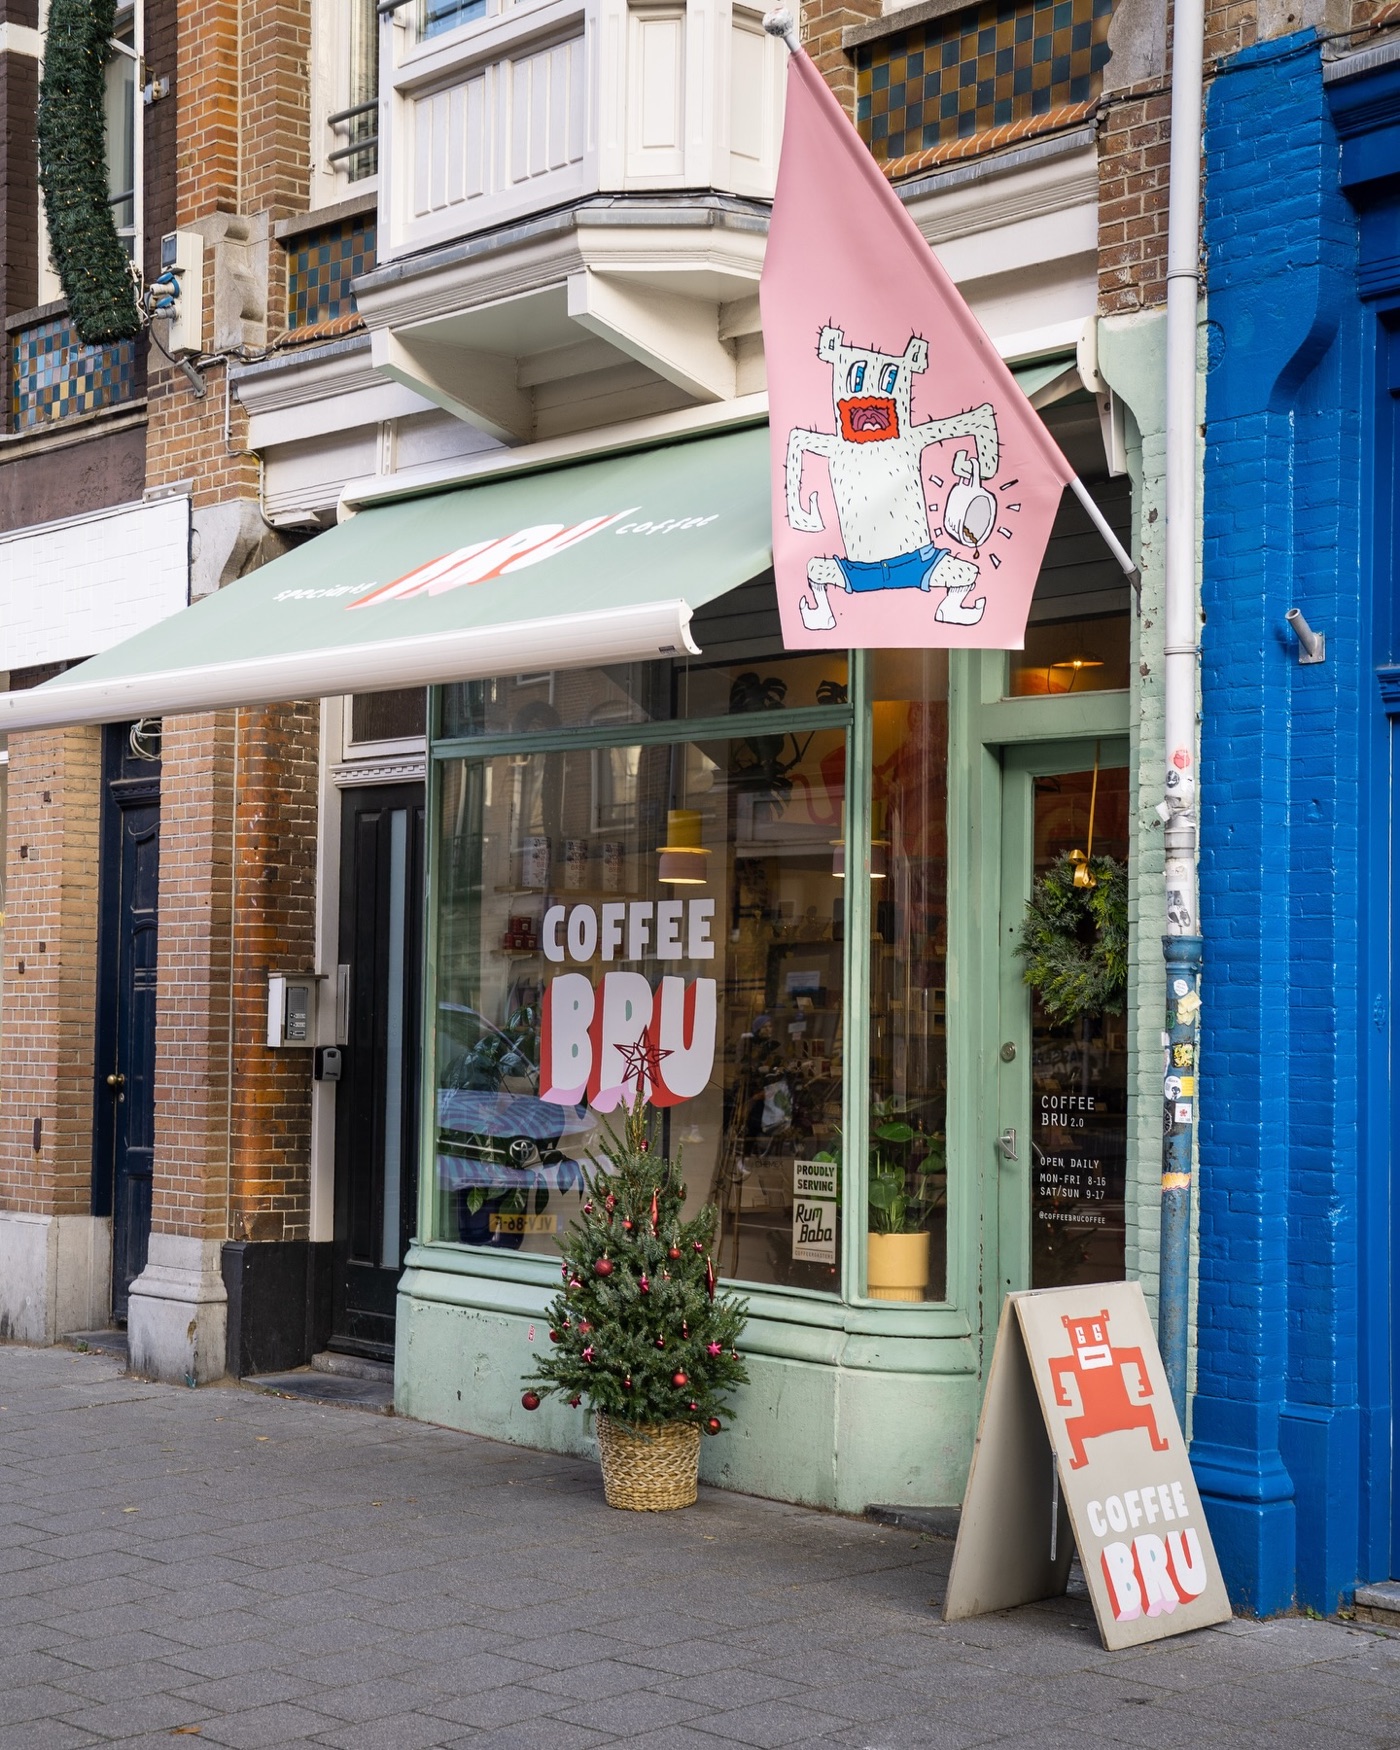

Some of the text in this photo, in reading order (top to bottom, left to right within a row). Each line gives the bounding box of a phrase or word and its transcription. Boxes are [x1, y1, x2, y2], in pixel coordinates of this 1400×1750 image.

[615, 514, 719, 536] coffee
[542, 898, 716, 963] COFFEE
[539, 972, 718, 1116] BRU
[1041, 1095, 1095, 1111] COFFEE
[1041, 1112, 1084, 1128] BRU 2.0
[1040, 1156, 1100, 1169] OPEN DAILY
[796, 1164, 835, 1178] PROUDLY
[797, 1178, 834, 1192] SERVING
[1040, 1173, 1107, 1187] MON-FRI 8-16
[1040, 1185, 1105, 1200] SAT/SUN 9-17
[795, 1203, 823, 1224] Rum
[1039, 1210, 1106, 1225] @COFFEEBRUCOFFEE
[797, 1223, 833, 1244] Baba
[1086, 1481, 1190, 1537] COFFEE
[1101, 1527, 1208, 1622] BRU
